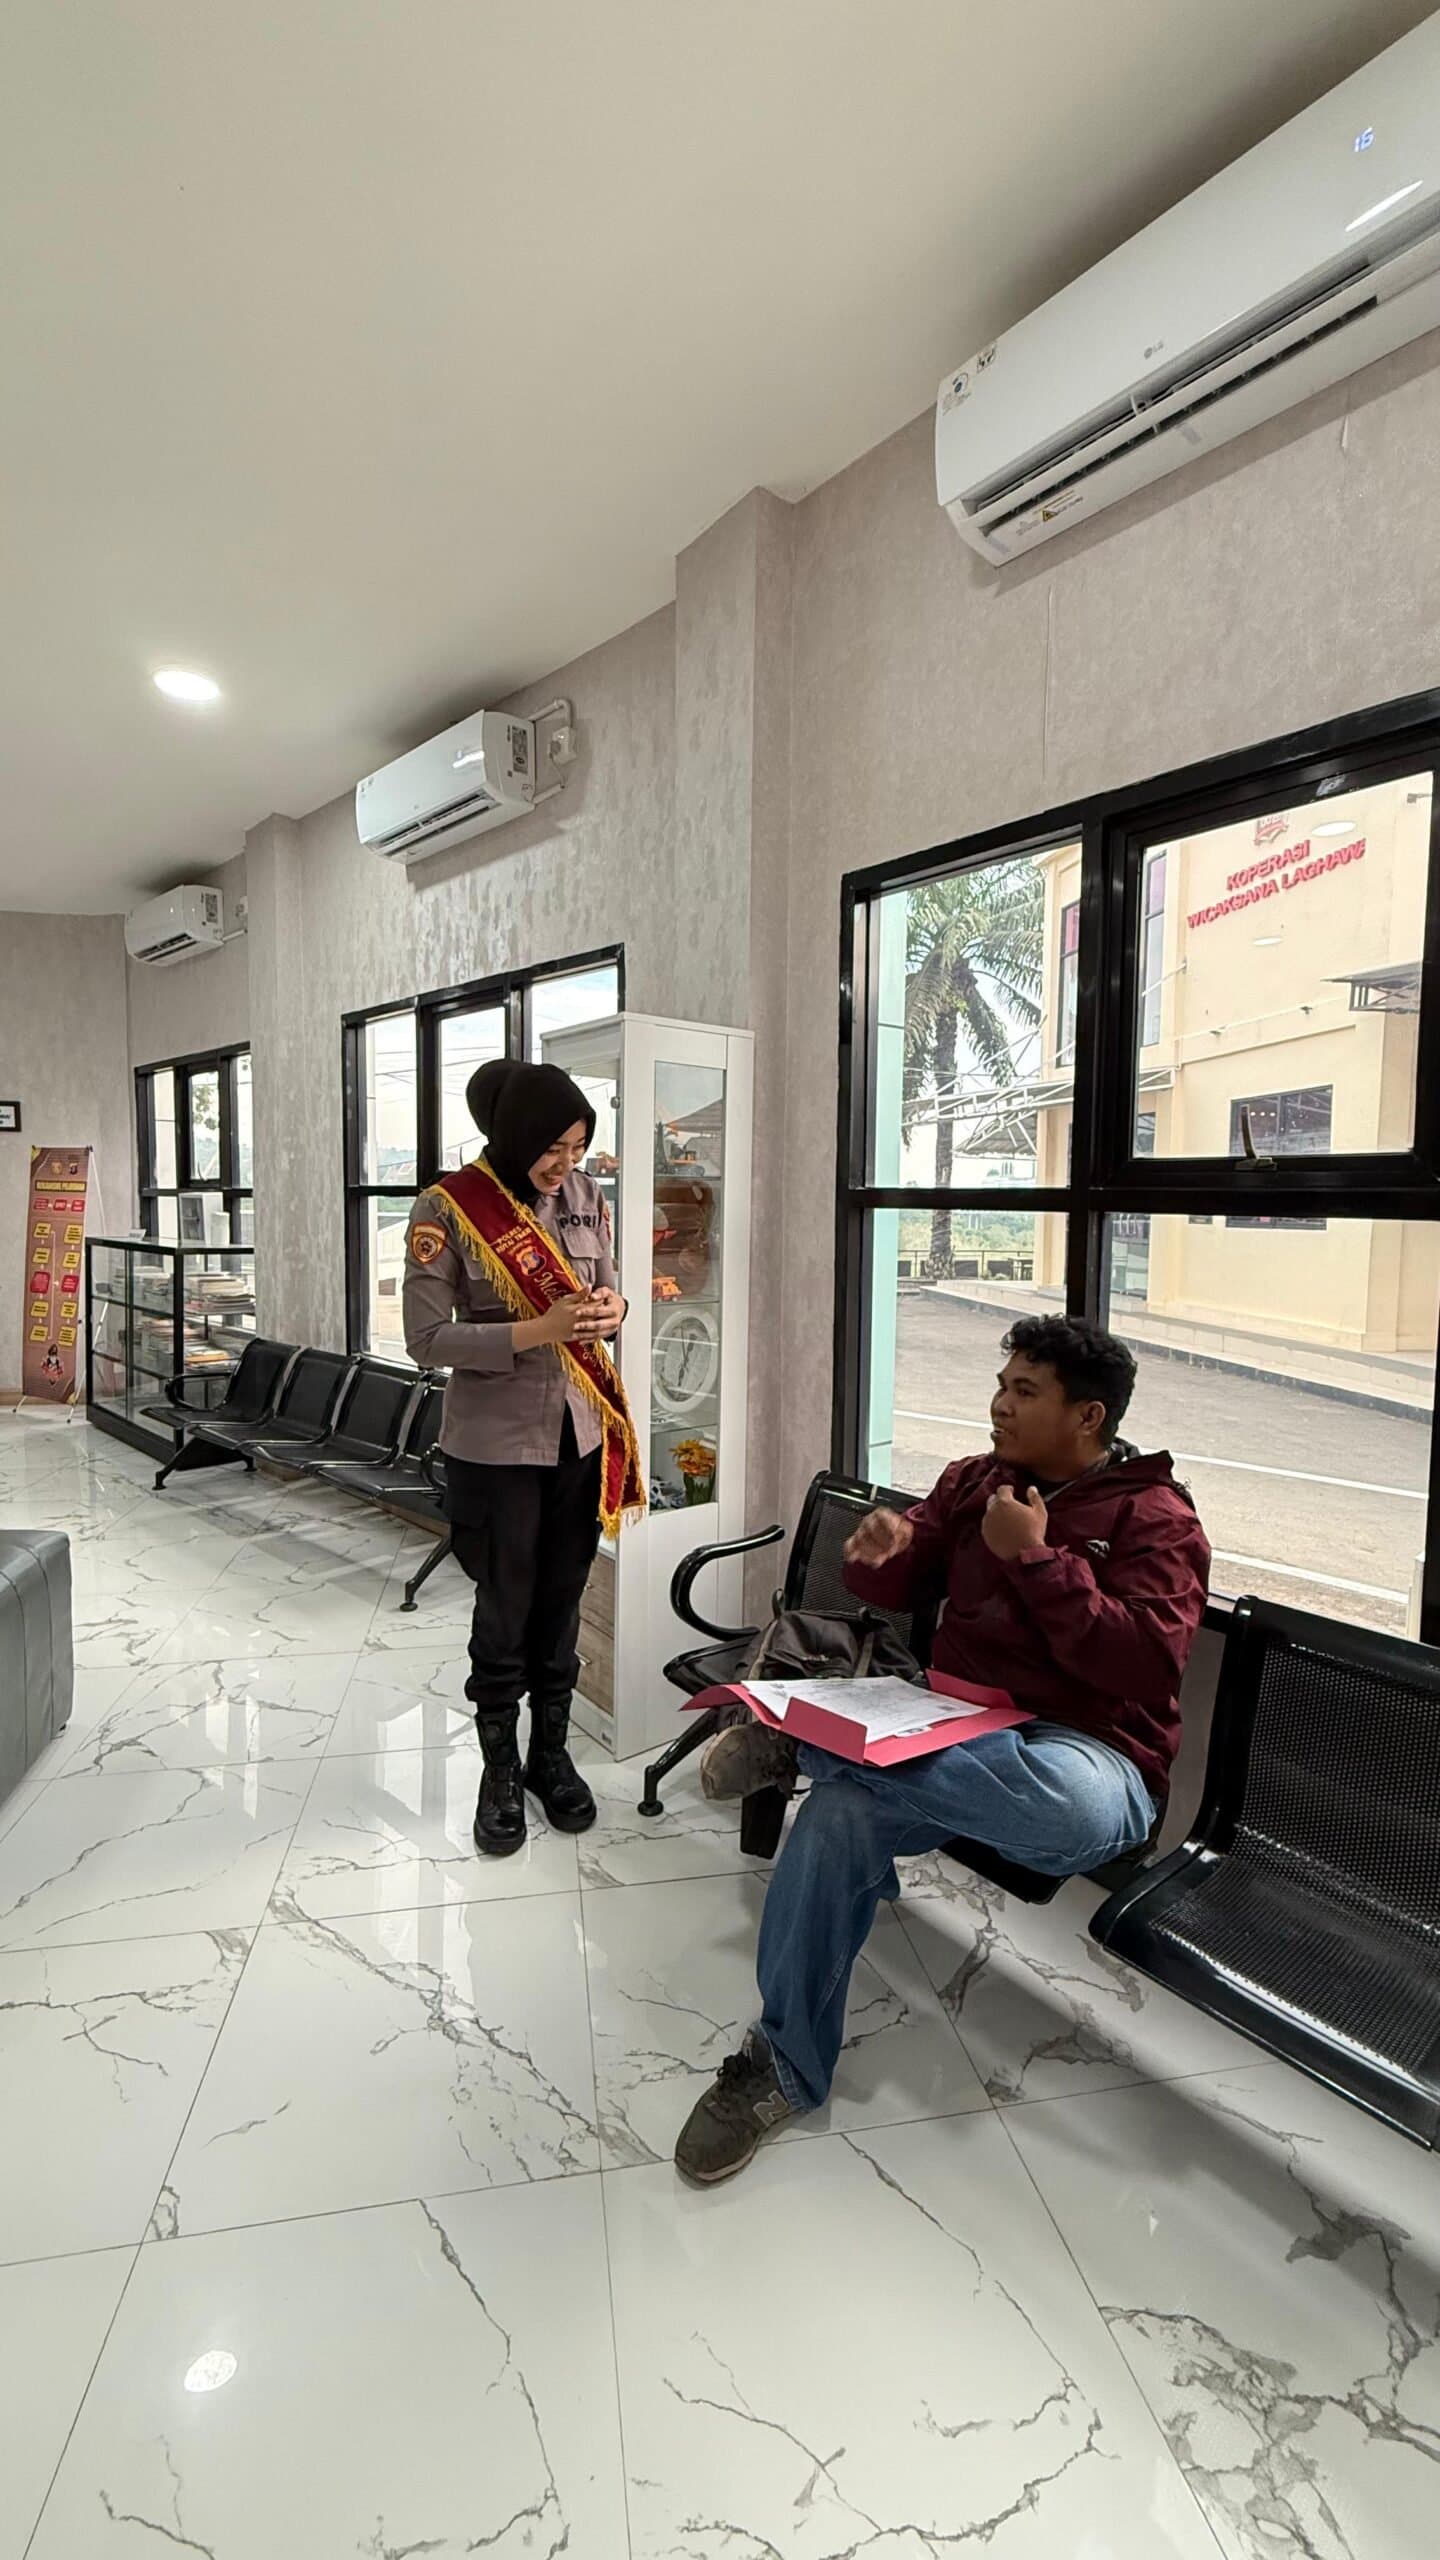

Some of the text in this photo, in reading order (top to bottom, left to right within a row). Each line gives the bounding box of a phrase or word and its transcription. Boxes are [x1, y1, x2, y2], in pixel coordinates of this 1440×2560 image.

[1226, 839, 1311, 892] KOPERASI
[1187, 879, 1280, 929] WICAKSANA
[559, 1214, 597, 1229] PORI
